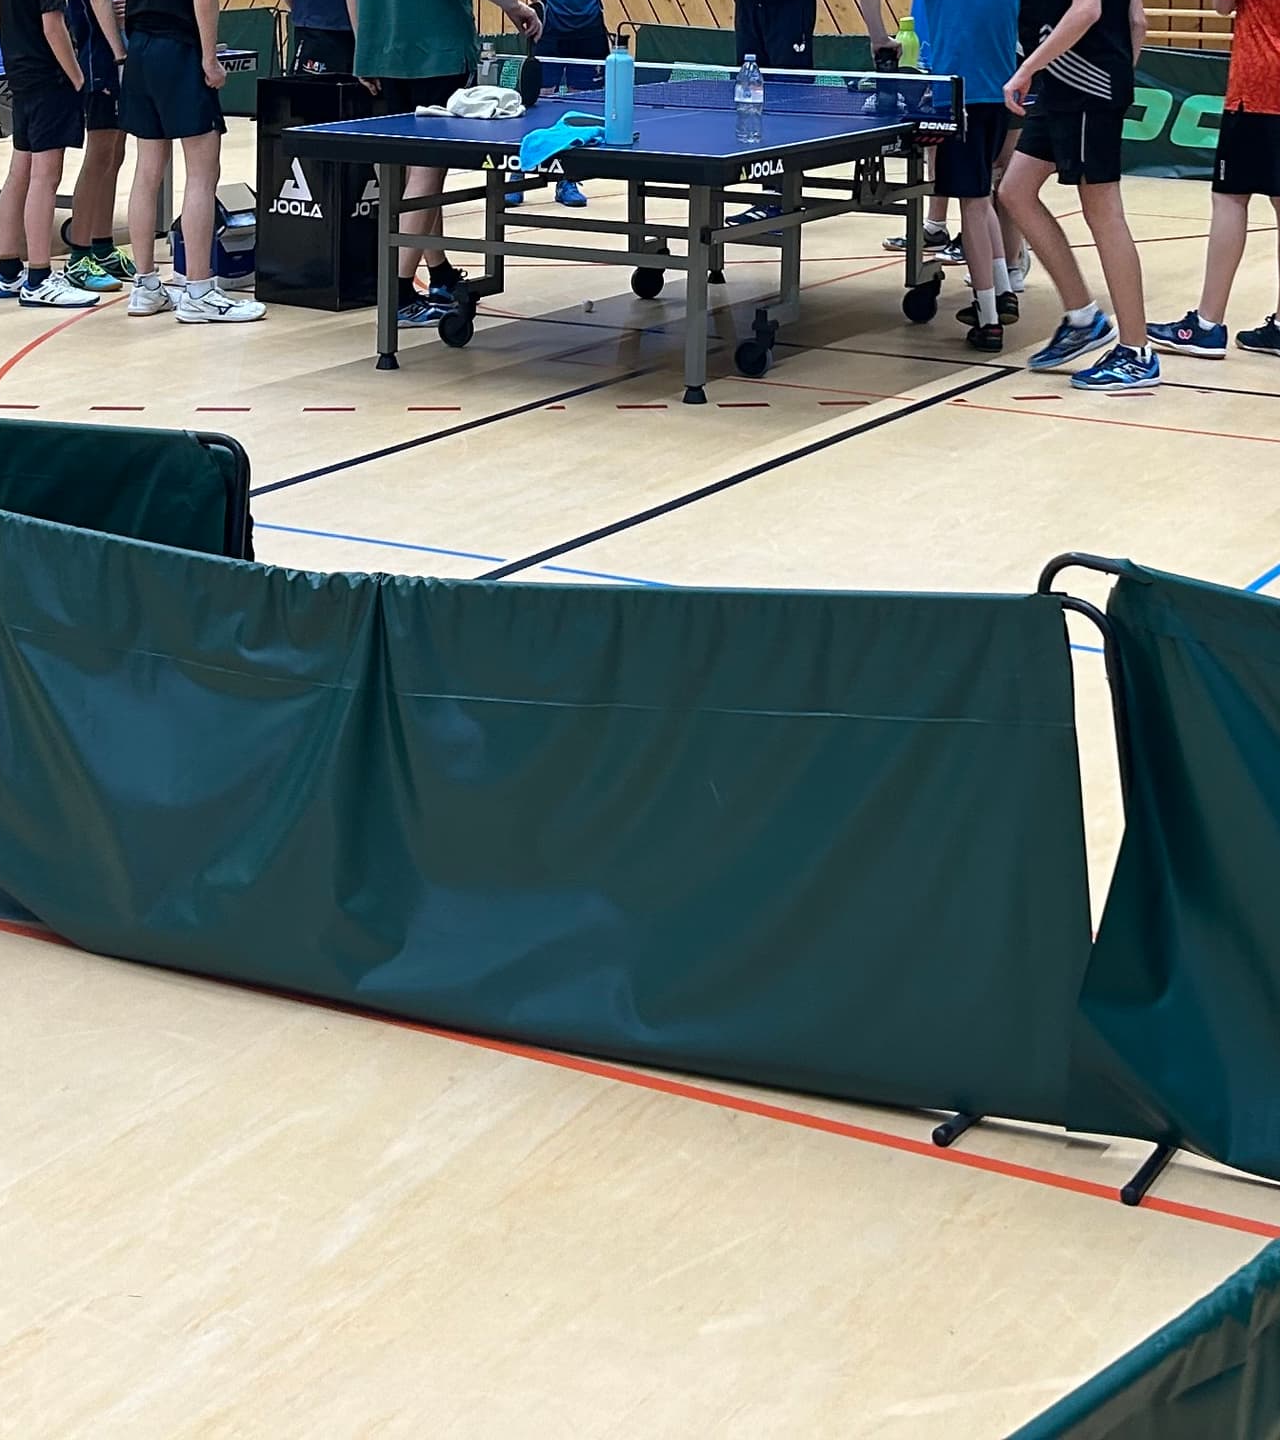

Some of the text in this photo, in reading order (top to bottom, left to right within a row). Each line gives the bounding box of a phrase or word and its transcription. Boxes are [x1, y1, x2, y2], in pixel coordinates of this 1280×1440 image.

[919, 121, 958, 132] DONIC
[748, 159, 785, 179] JOOLA
[269, 199, 324, 219] JOOLA
